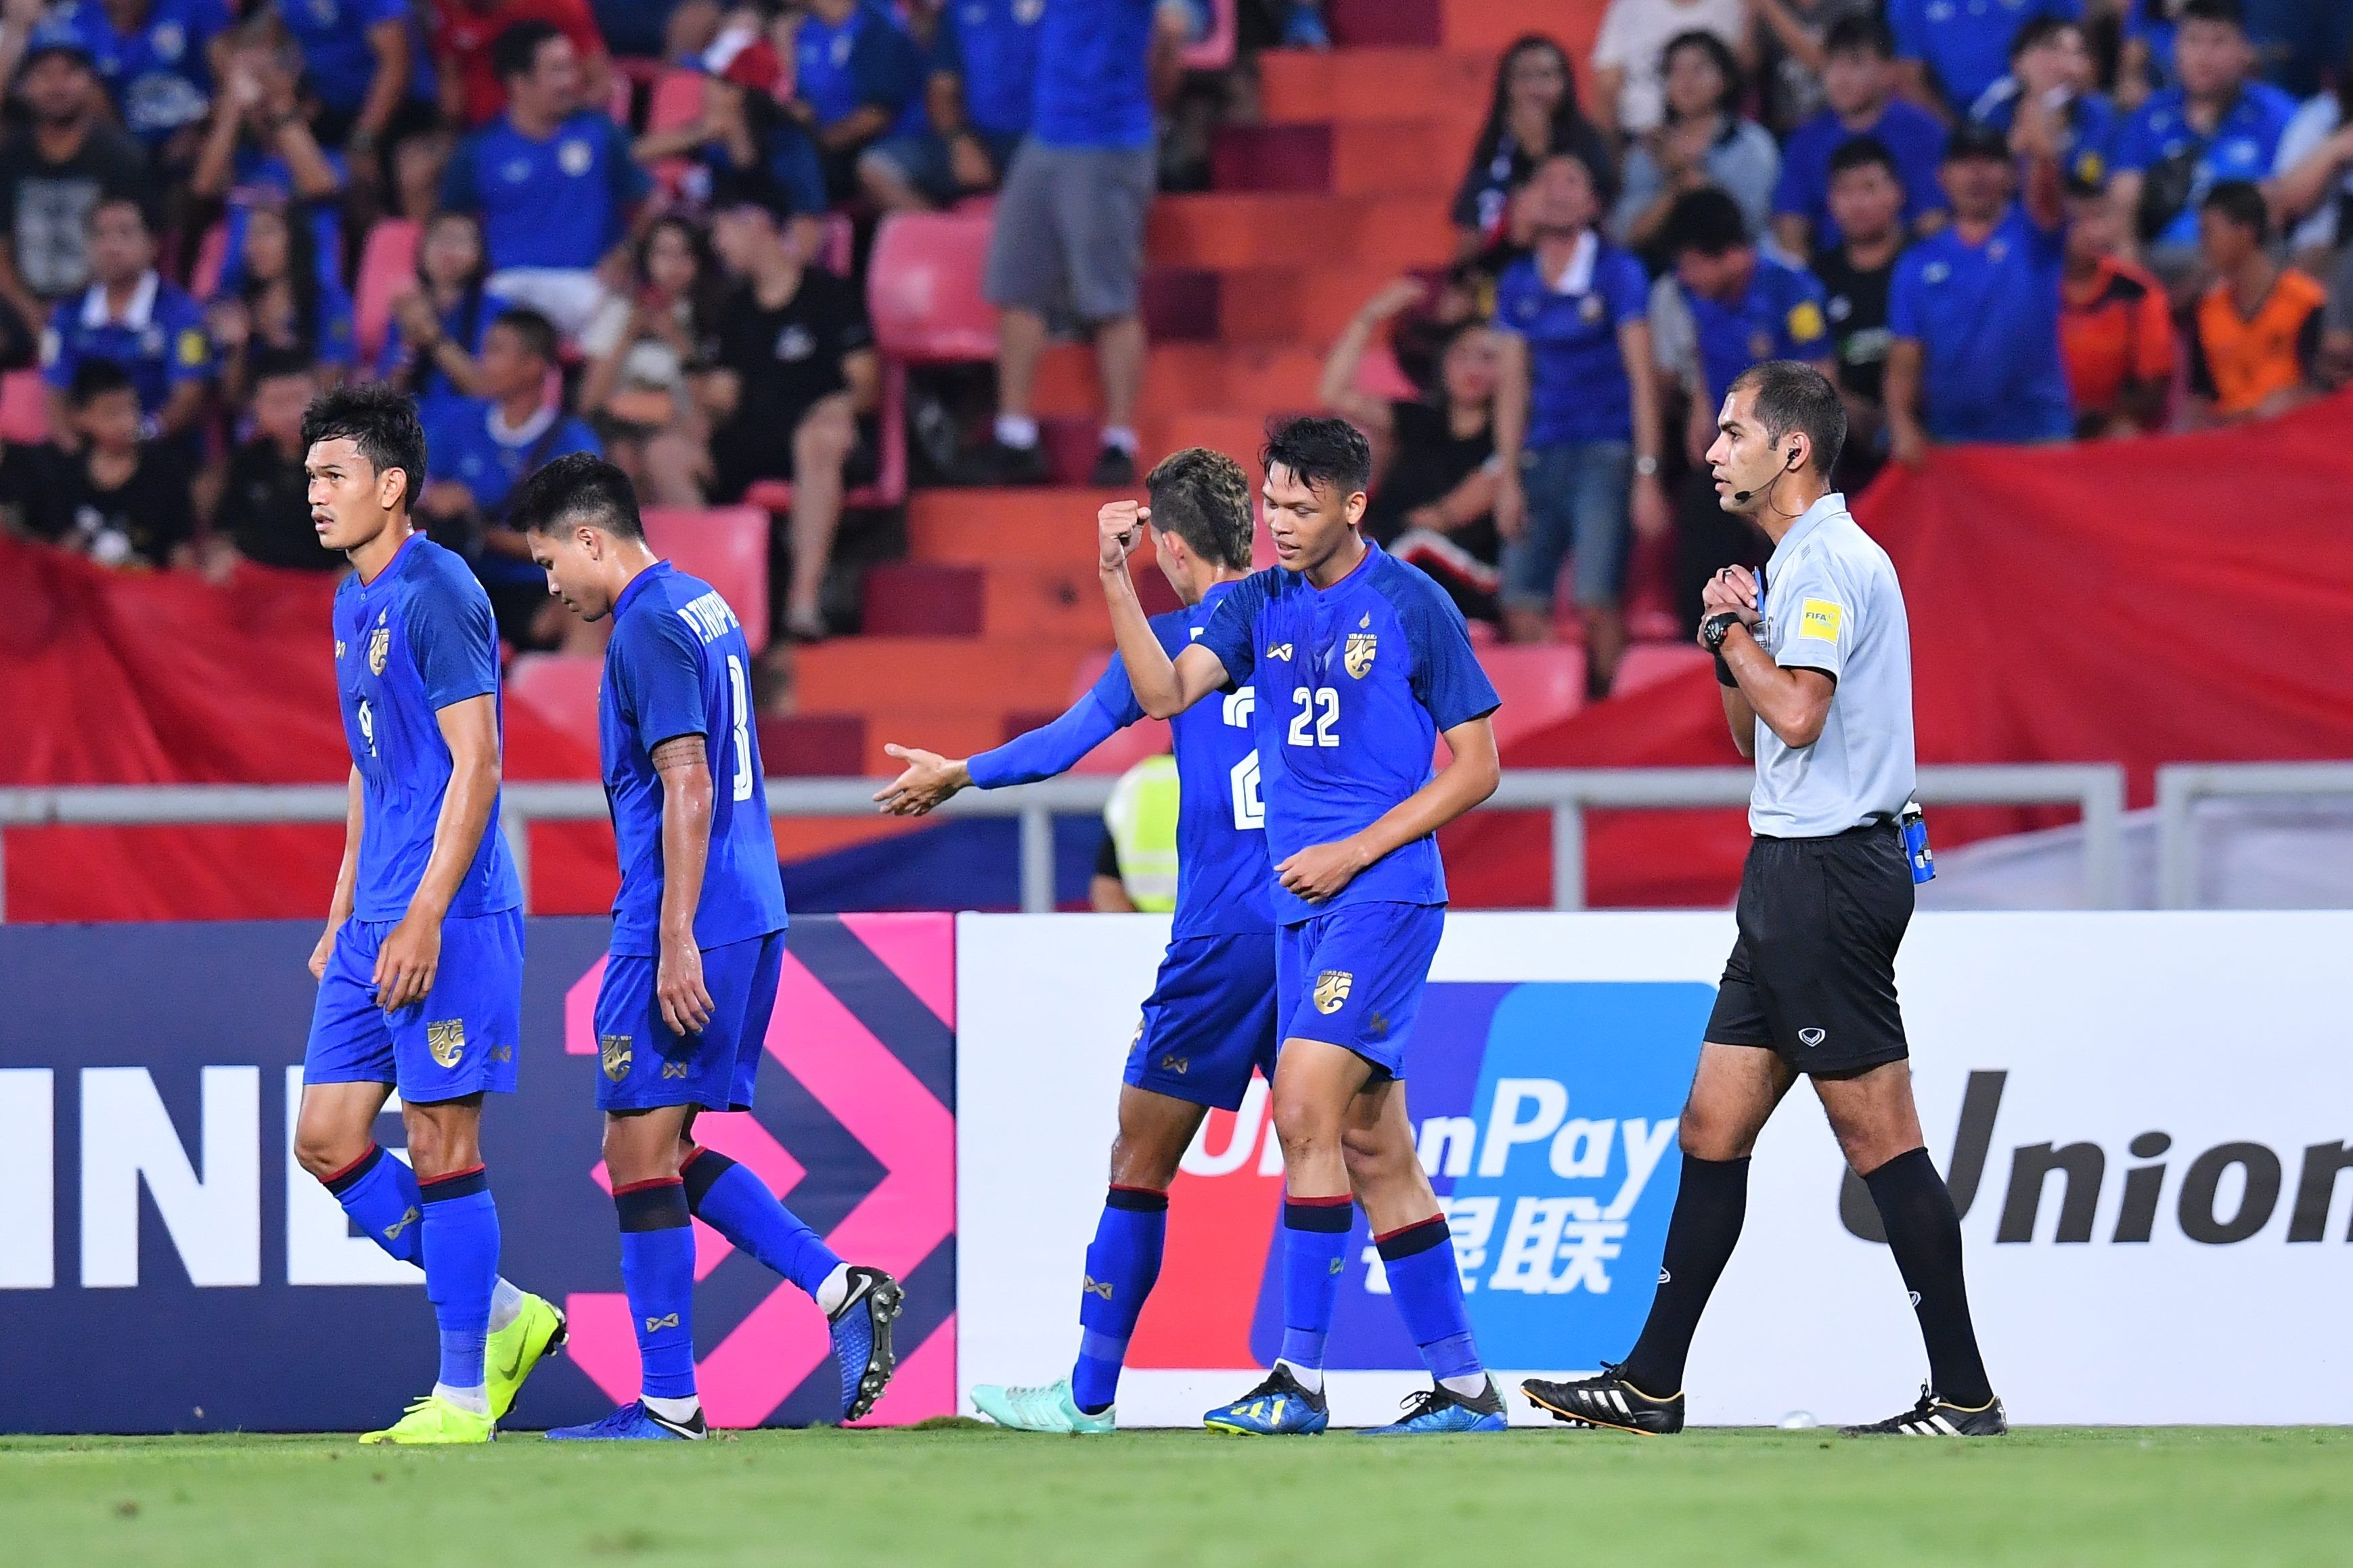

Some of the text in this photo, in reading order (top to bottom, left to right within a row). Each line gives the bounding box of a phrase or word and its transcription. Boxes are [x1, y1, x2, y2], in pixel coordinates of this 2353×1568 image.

[1806, 612, 1827, 621] FIFA
[358, 700, 377, 757] 9
[1287, 687, 1339, 747] 22
